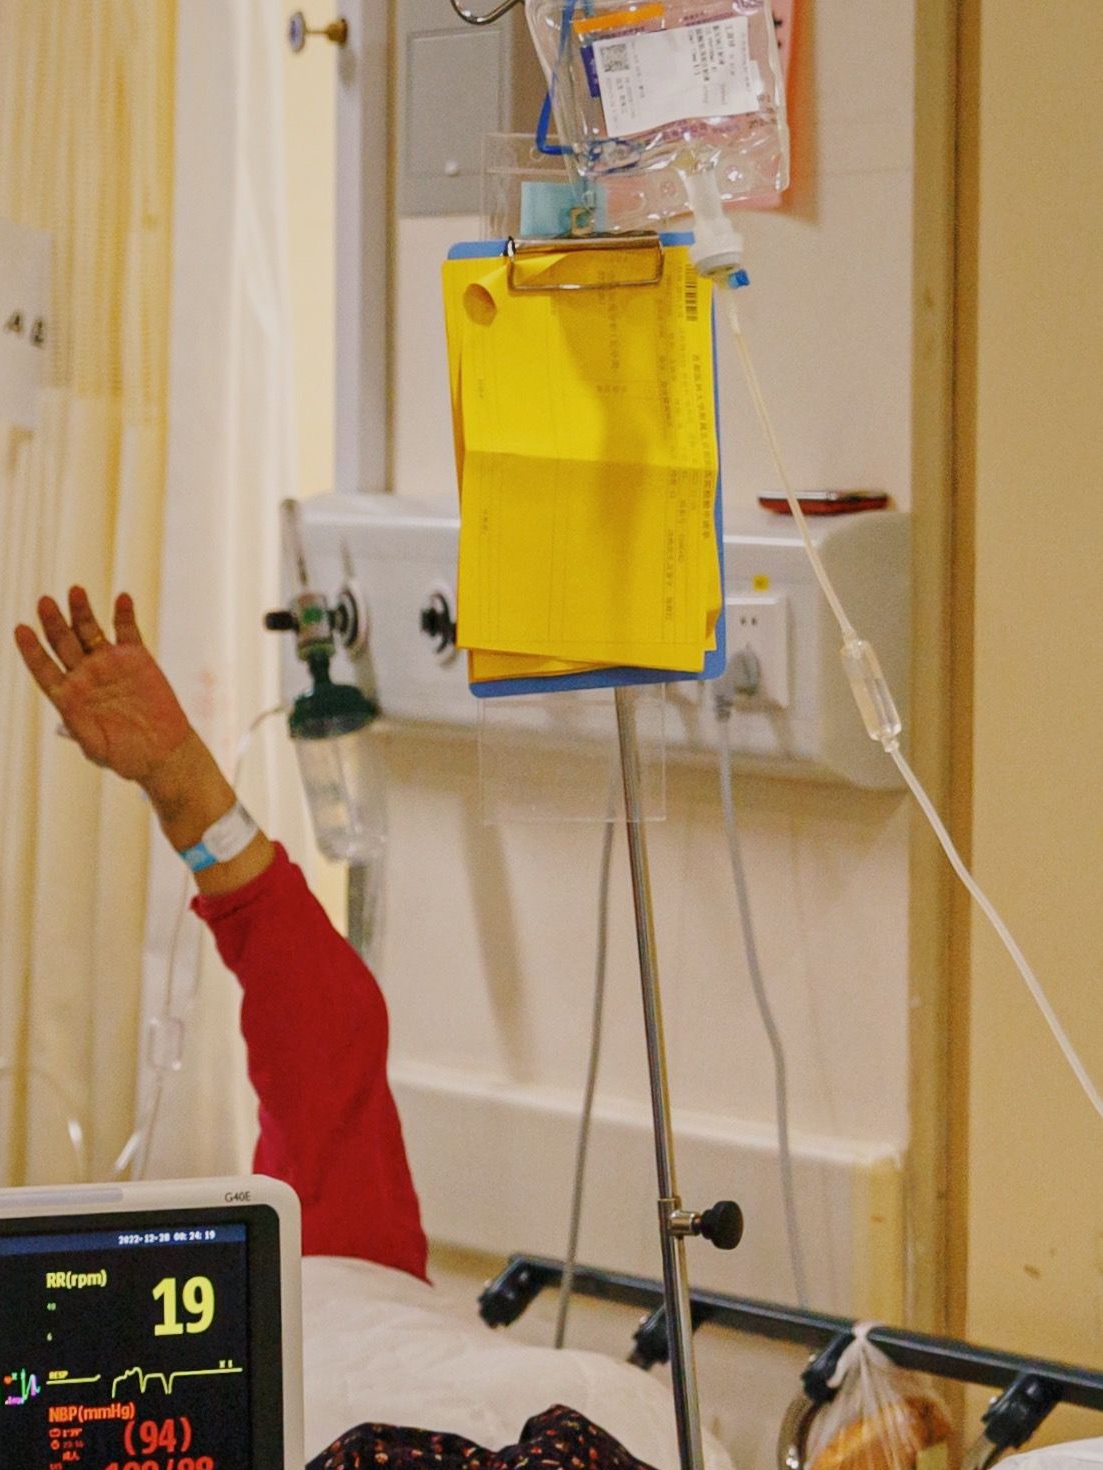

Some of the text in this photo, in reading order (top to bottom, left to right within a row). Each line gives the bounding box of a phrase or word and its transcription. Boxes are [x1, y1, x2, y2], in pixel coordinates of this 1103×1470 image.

[46, 1269, 107, 1289] RR(rpm)
[152, 1276, 216, 1336] 19
[48, 1403, 135, 1422] NBP(mmHg)
